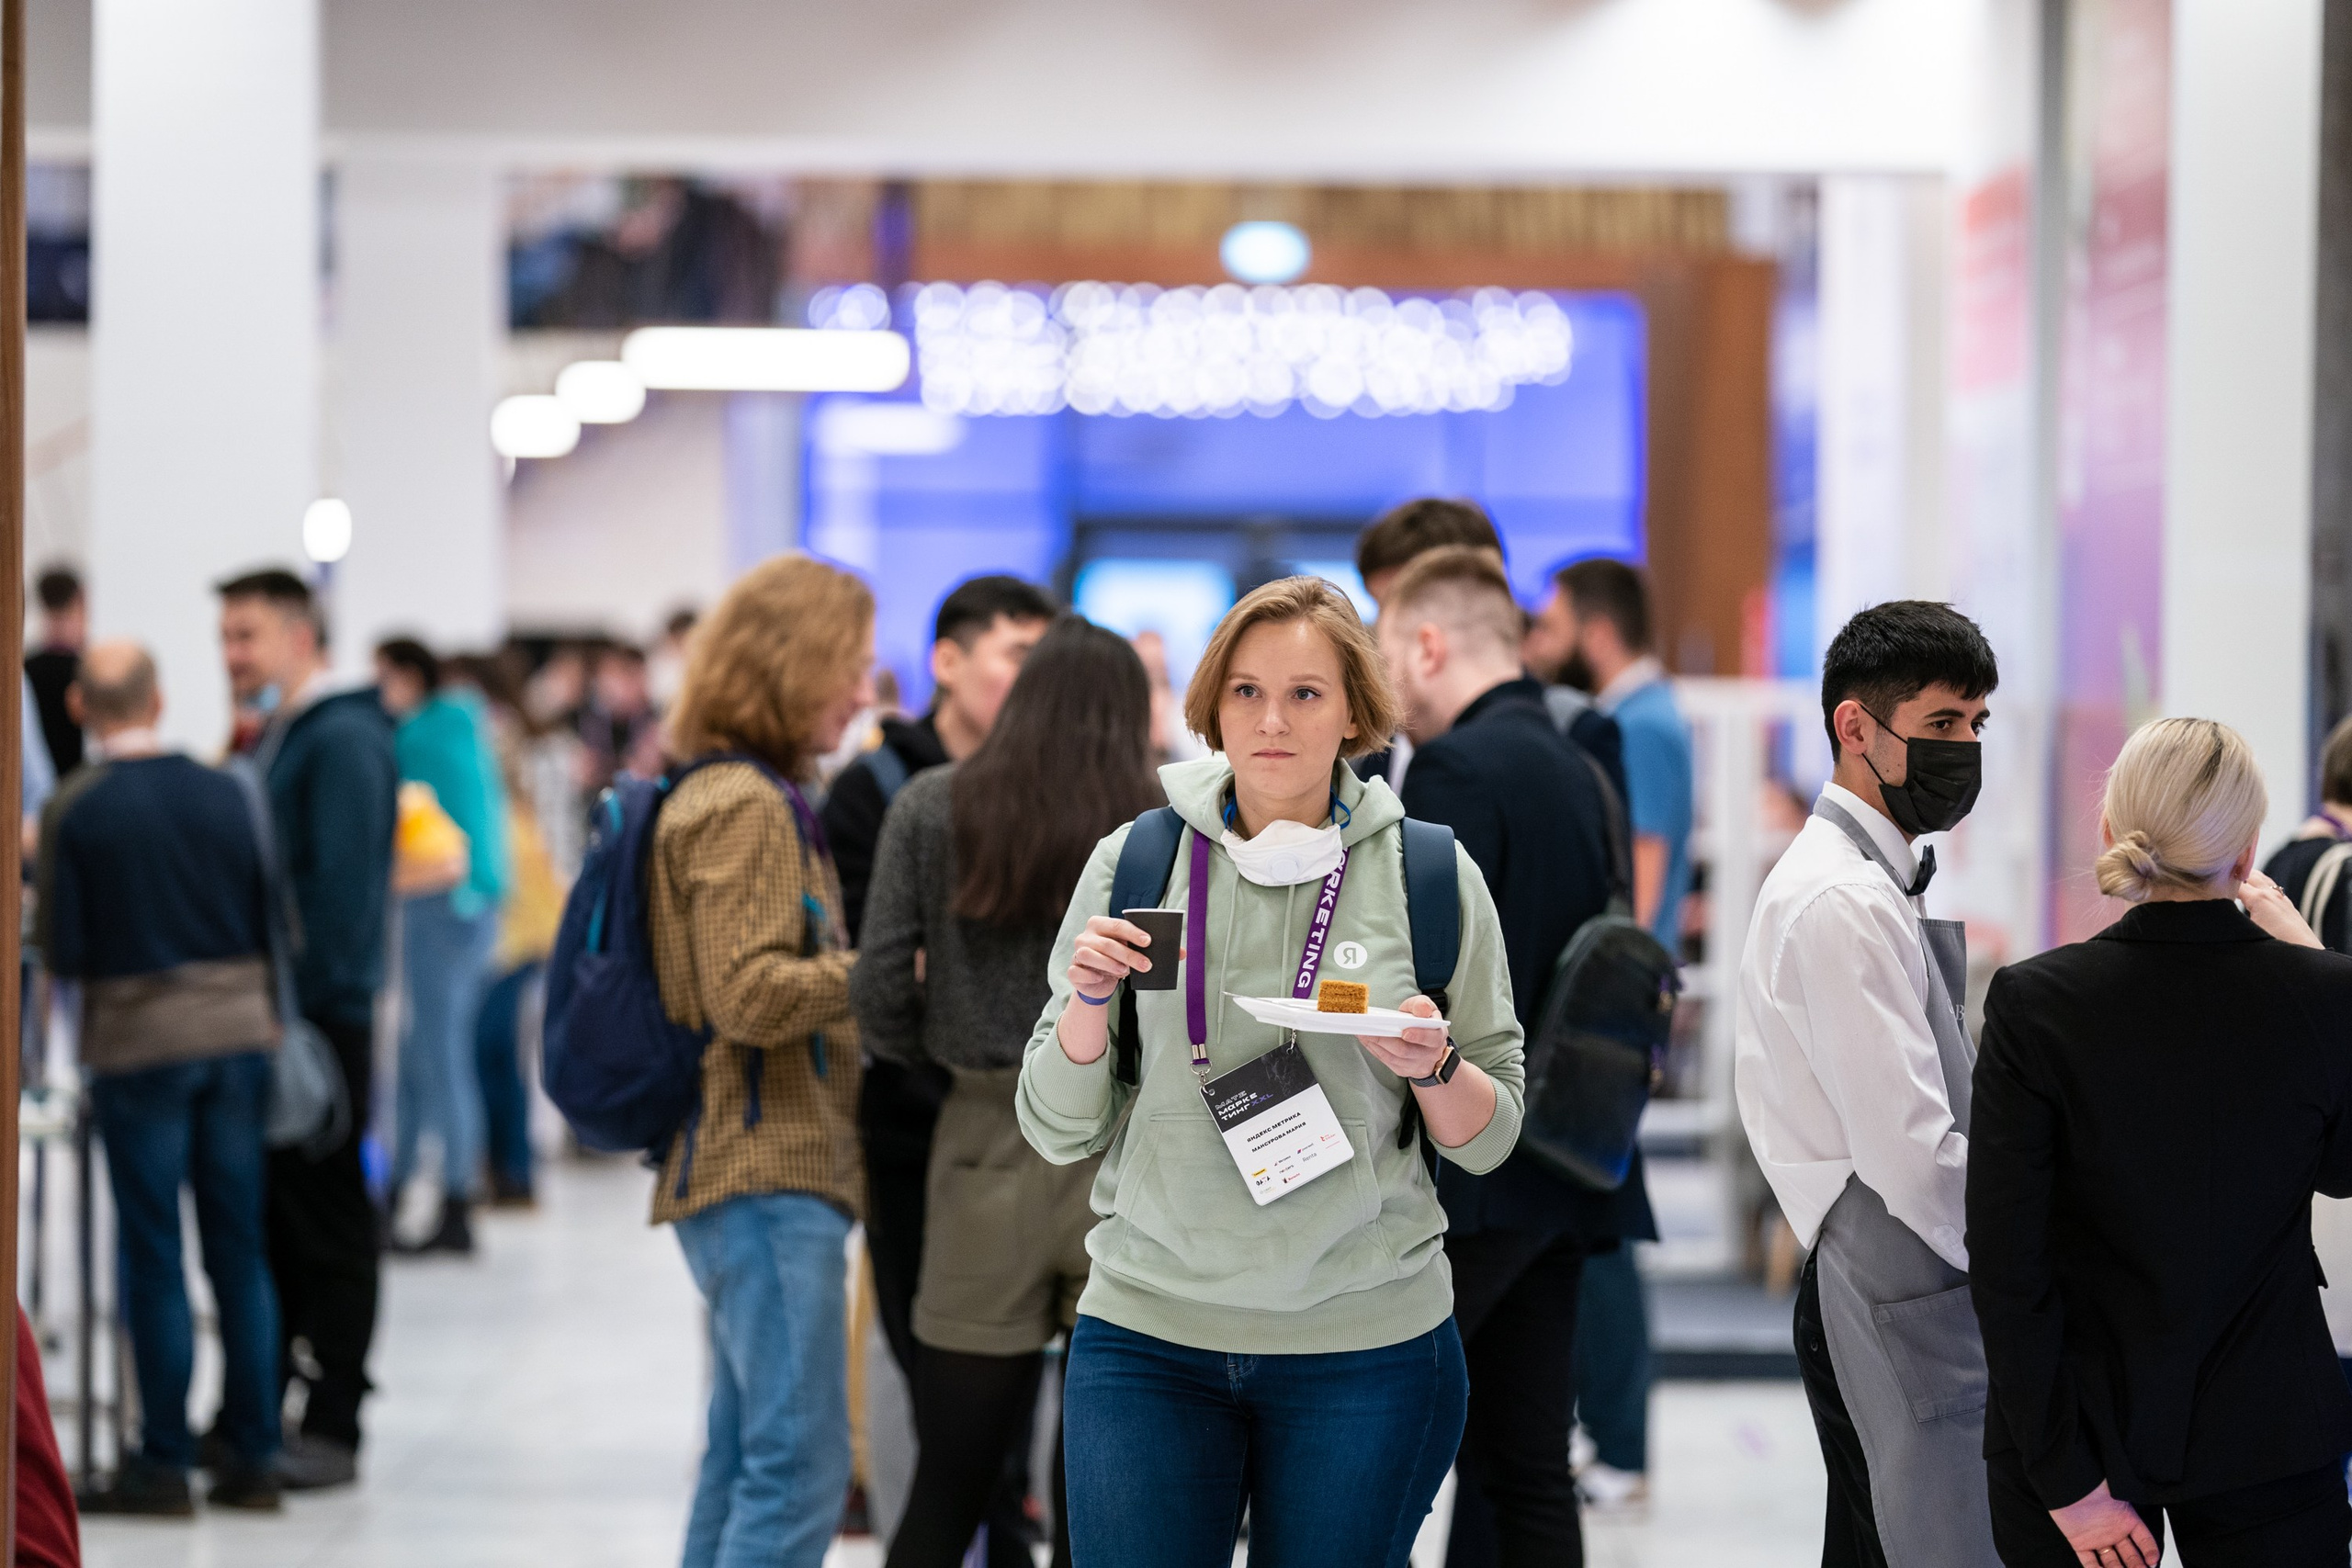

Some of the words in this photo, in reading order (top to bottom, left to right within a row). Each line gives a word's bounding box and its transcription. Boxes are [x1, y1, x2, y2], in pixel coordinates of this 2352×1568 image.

[1250, 1093, 1273, 1107] XXL
[1247, 1127, 1272, 1143] ЯНДЕКС
[1272, 1111, 1301, 1130] МЕТРИКА
[1251, 1133, 1286, 1153] МАНСУРОВА
[1285, 1122, 1306, 1135] МАРИЯ
[1302, 1152, 1317, 1162] Renta
